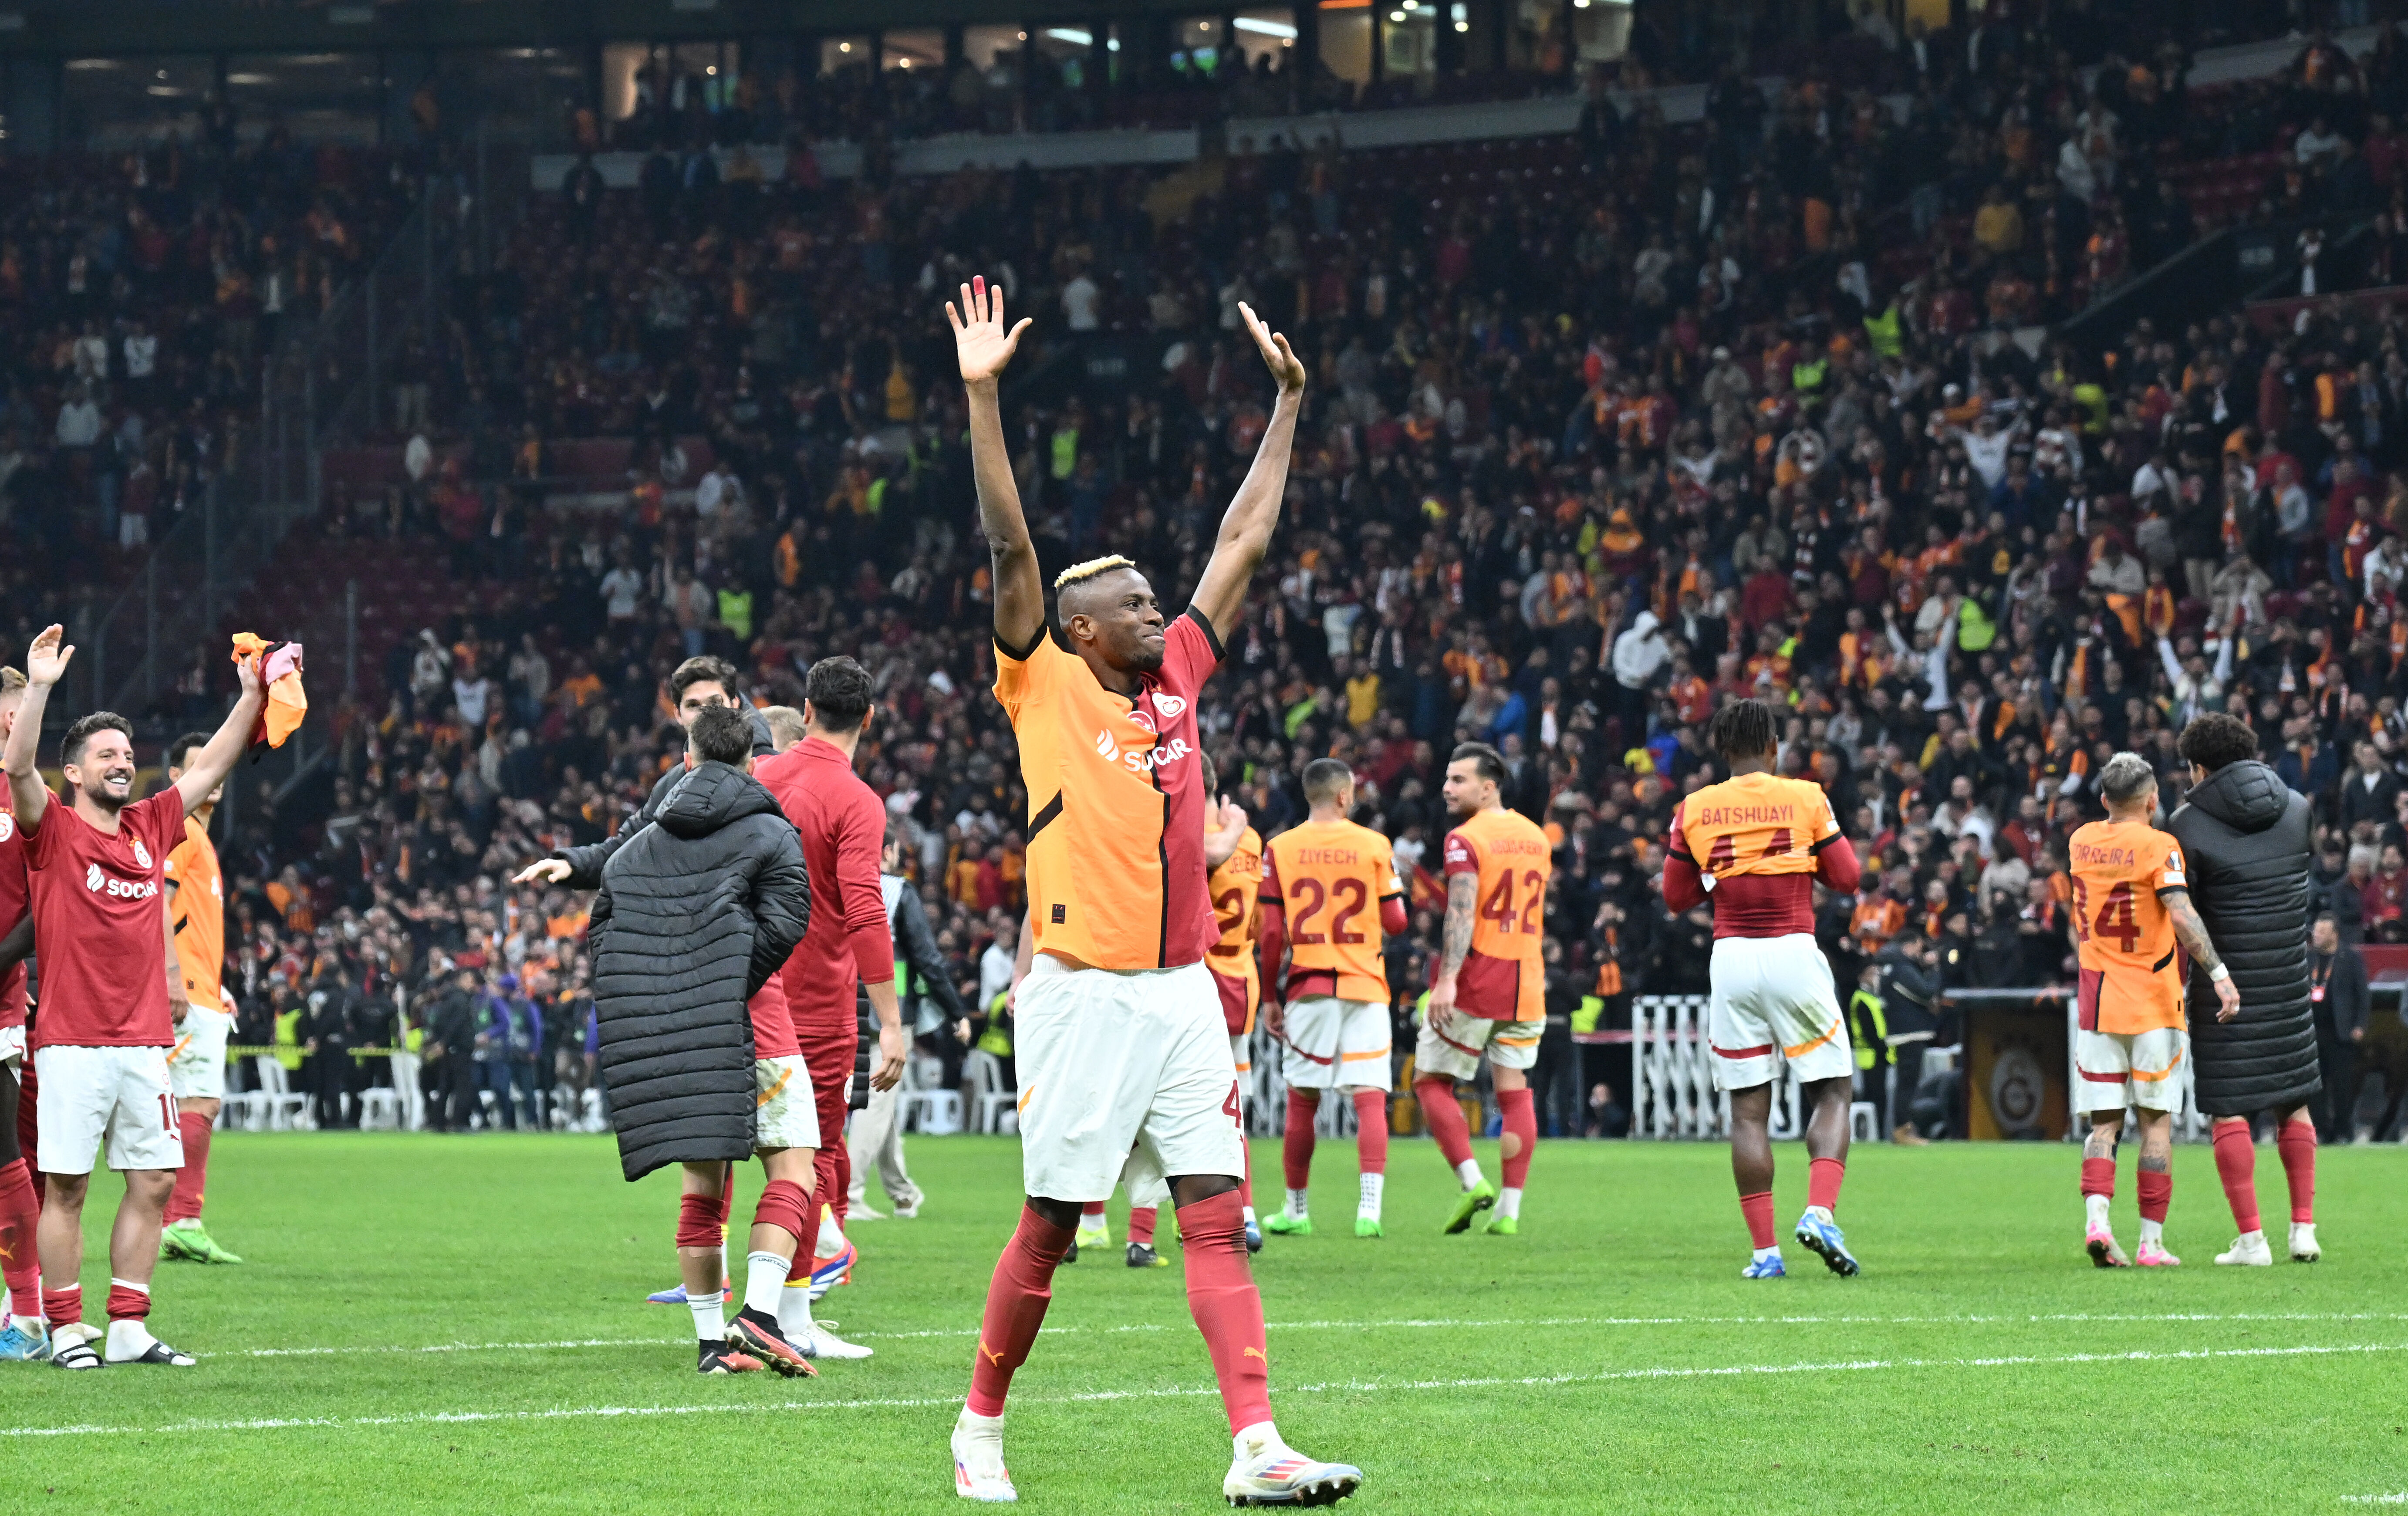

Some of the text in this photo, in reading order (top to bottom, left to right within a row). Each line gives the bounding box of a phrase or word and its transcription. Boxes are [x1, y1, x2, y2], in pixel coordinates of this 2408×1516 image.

[1124, 738, 1193, 772] SOCAR
[1702, 805, 1793, 825] BATSHUAYI
[1299, 849, 1358, 864] ZIYECH
[107, 879, 158, 899] SOCAR
[1482, 868, 1542, 935] 42
[1290, 877, 1366, 945] 22
[1222, 1079, 1241, 1129] 4
